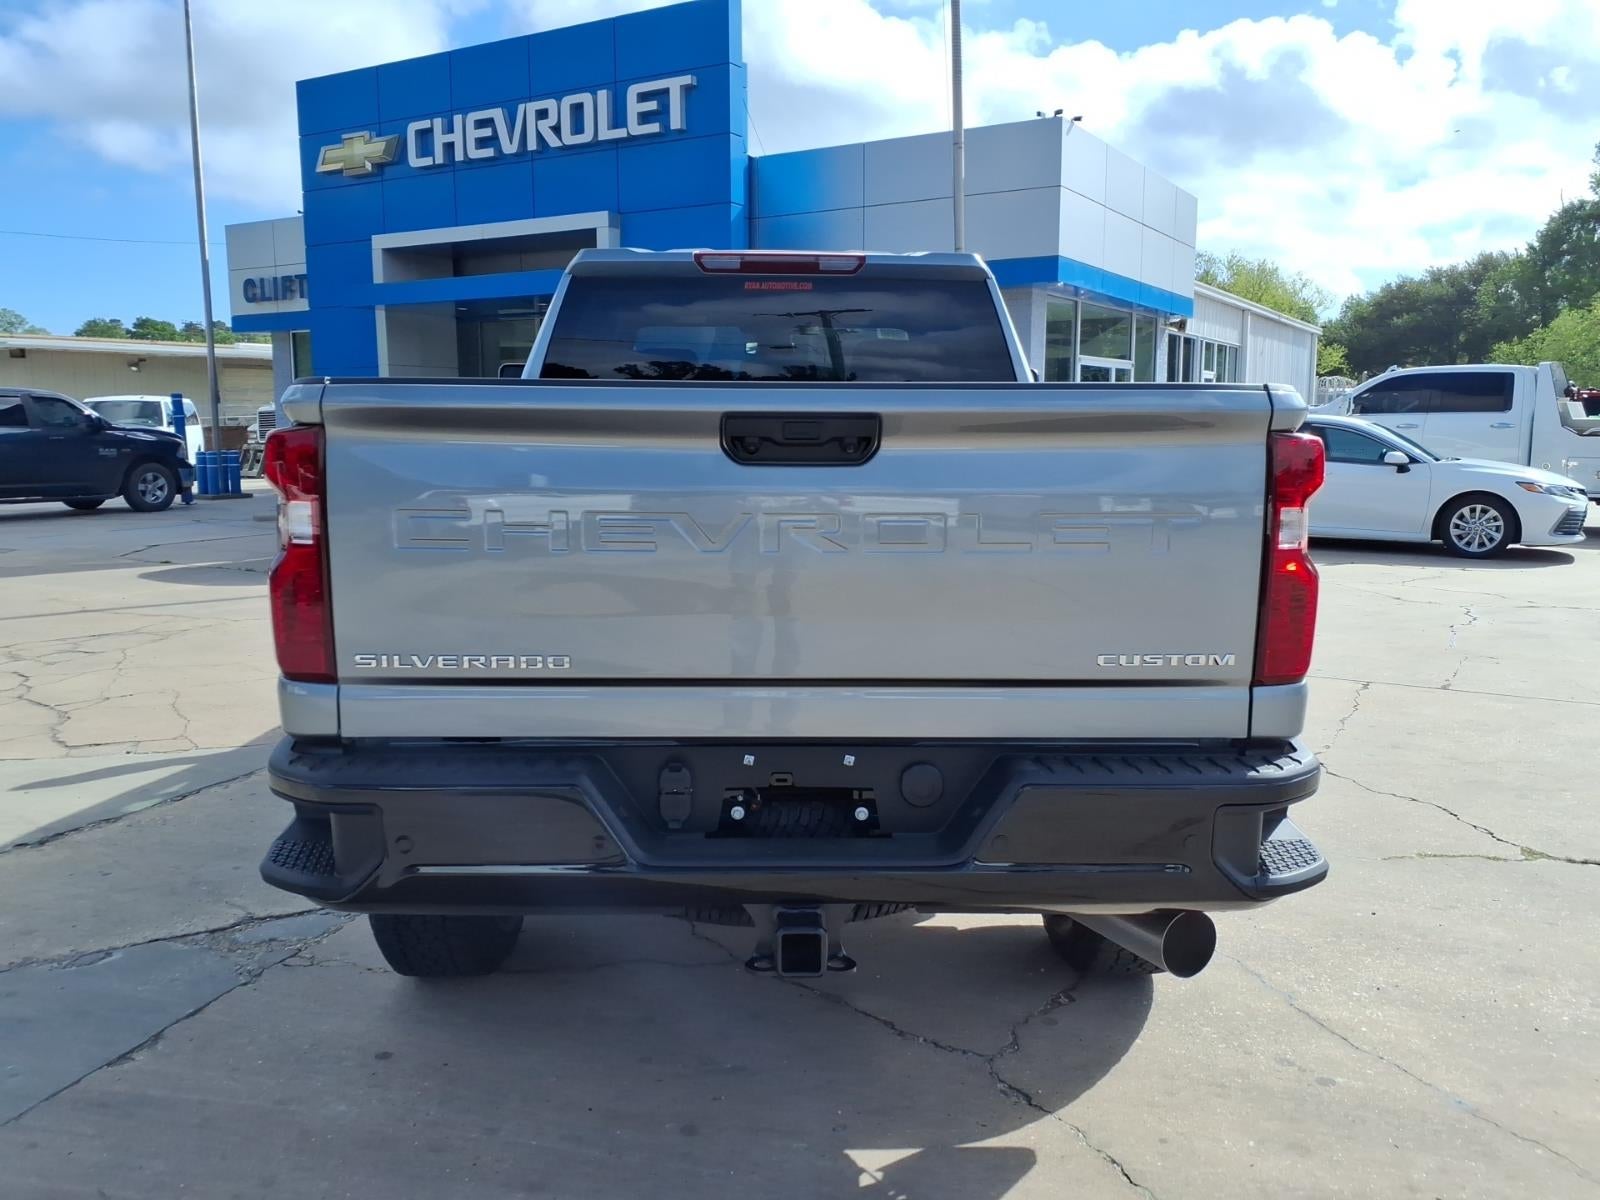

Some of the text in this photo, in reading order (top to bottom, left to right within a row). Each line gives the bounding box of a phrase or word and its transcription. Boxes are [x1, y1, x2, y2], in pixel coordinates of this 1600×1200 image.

[407, 74, 697, 168] CHEVROLET
[393, 508, 1201, 554] CHEVROLET
[354, 653, 571, 670] SILVERADO
[1097, 653, 1236, 667] CUSTOM
